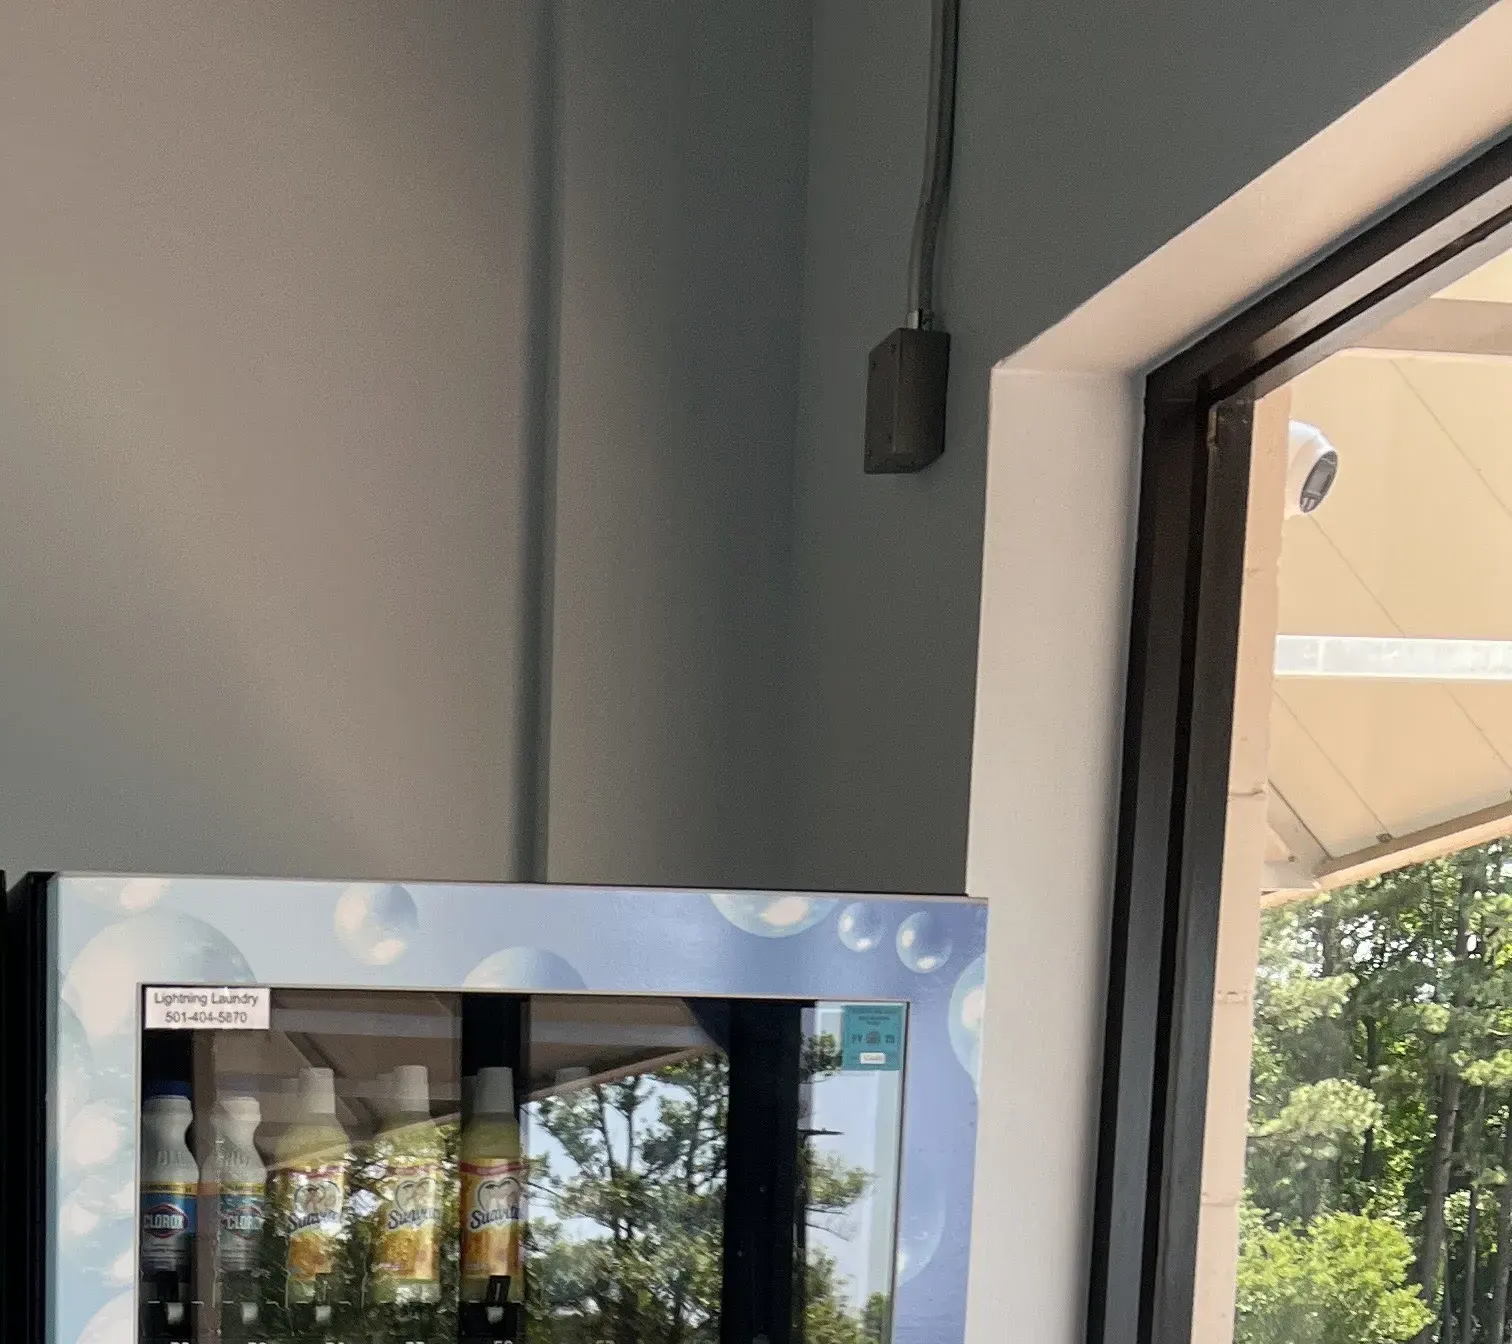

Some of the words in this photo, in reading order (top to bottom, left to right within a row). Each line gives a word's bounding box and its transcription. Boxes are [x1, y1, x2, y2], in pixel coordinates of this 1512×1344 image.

[154, 991, 208, 1008] Lightning
[211, 992, 259, 1008] Laundry
[165, 1011, 248, 1025] 501-404-5870
[226, 1214, 263, 1231] CLOR
